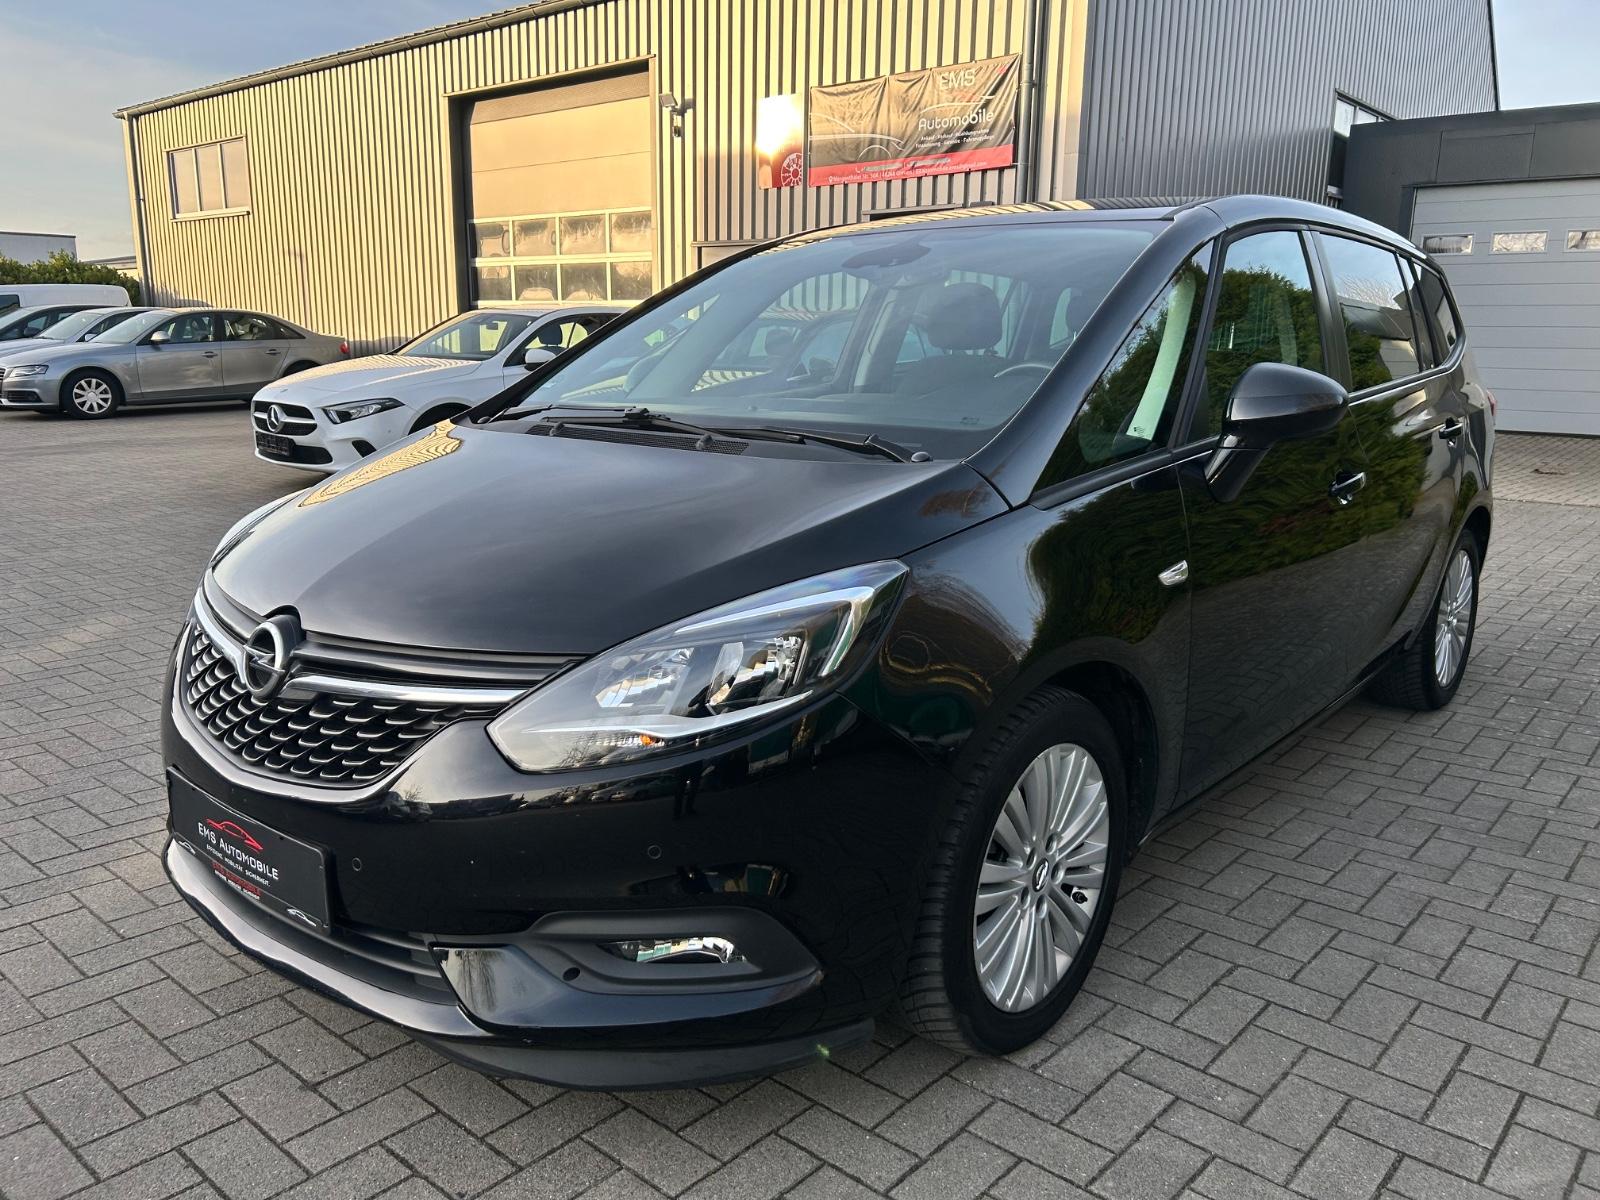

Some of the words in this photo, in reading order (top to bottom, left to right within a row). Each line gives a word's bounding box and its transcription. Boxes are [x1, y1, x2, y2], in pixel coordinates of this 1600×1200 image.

[940, 69, 975, 90] EMS
[918, 108, 994, 131] Automobile
[198, 822, 217, 844] EMS
[219, 838, 280, 880] AUTOMOBILE
